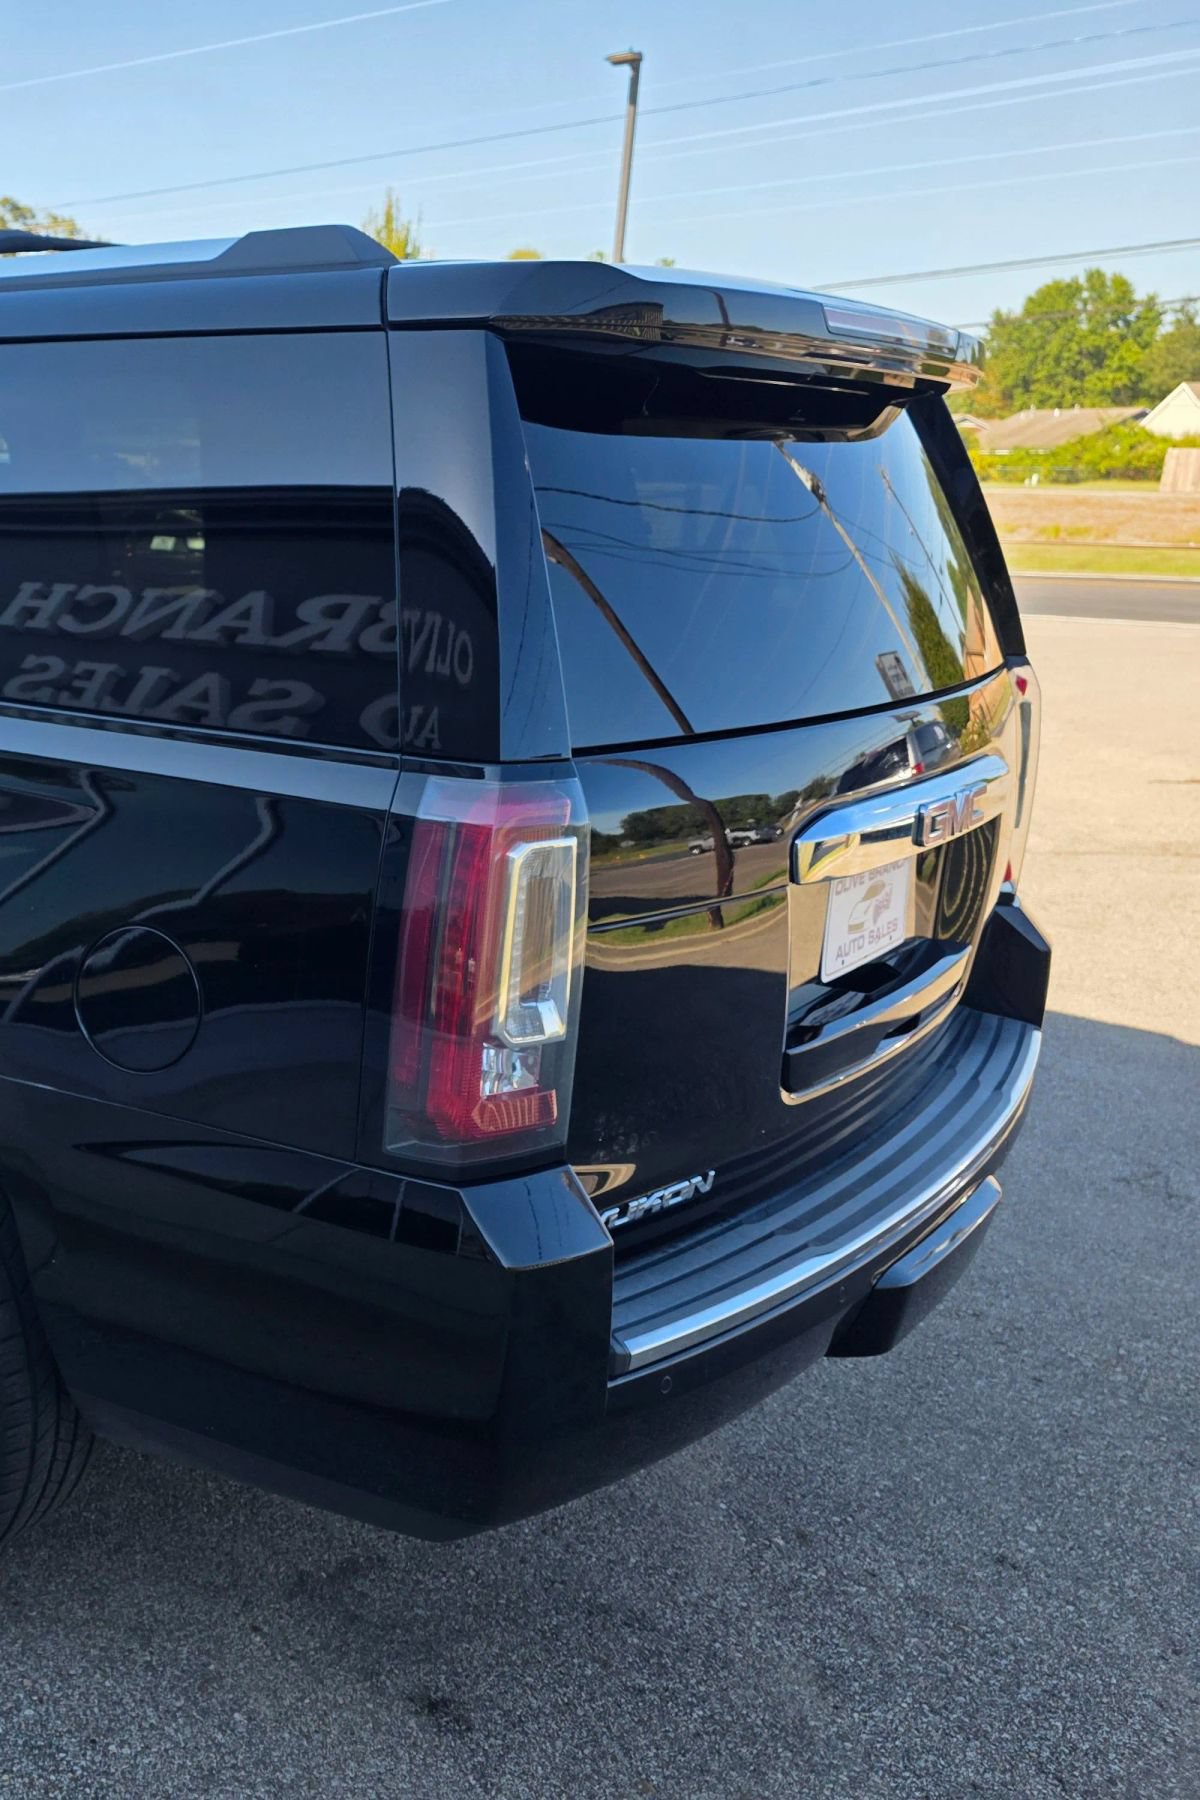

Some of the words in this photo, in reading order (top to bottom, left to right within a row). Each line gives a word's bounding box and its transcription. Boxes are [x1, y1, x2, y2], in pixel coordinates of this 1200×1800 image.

[912, 781, 988, 847] GMC
[834, 933, 865, 961] AUTO
[867, 917, 899, 945] SALES
